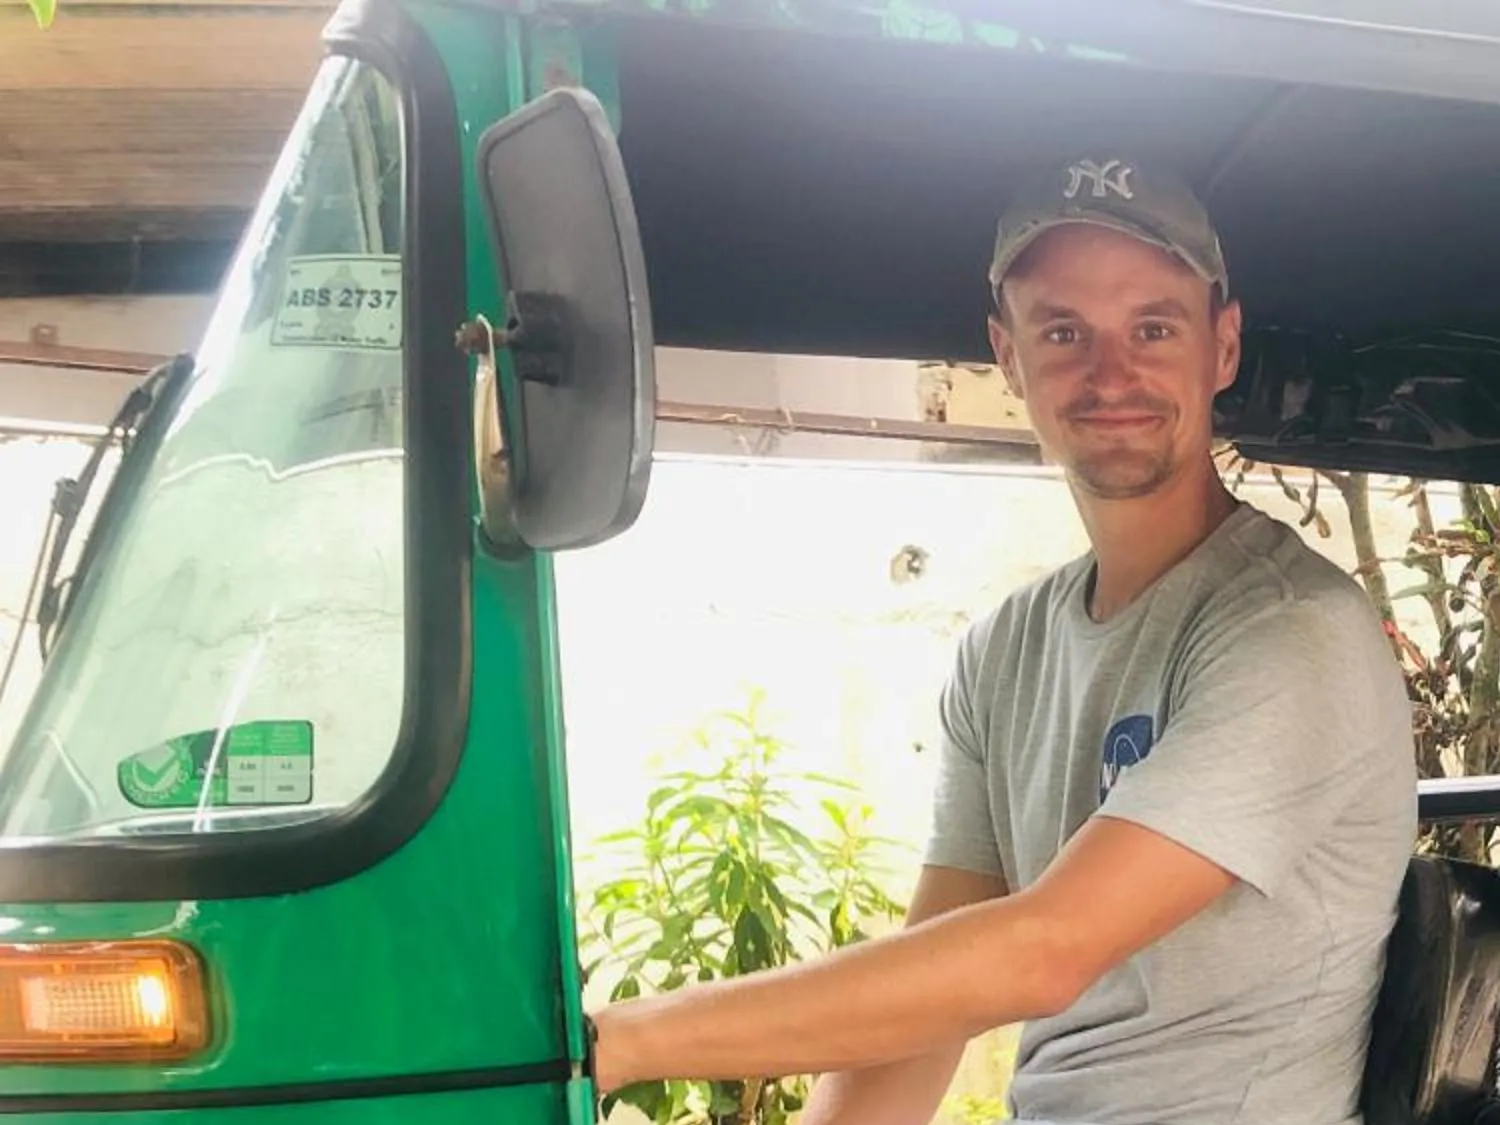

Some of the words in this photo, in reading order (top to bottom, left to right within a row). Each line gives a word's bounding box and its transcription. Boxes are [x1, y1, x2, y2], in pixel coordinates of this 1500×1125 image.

[1063, 159, 1134, 199] NY
[286, 287, 332, 308] ABS
[338, 287, 399, 310] 2737
